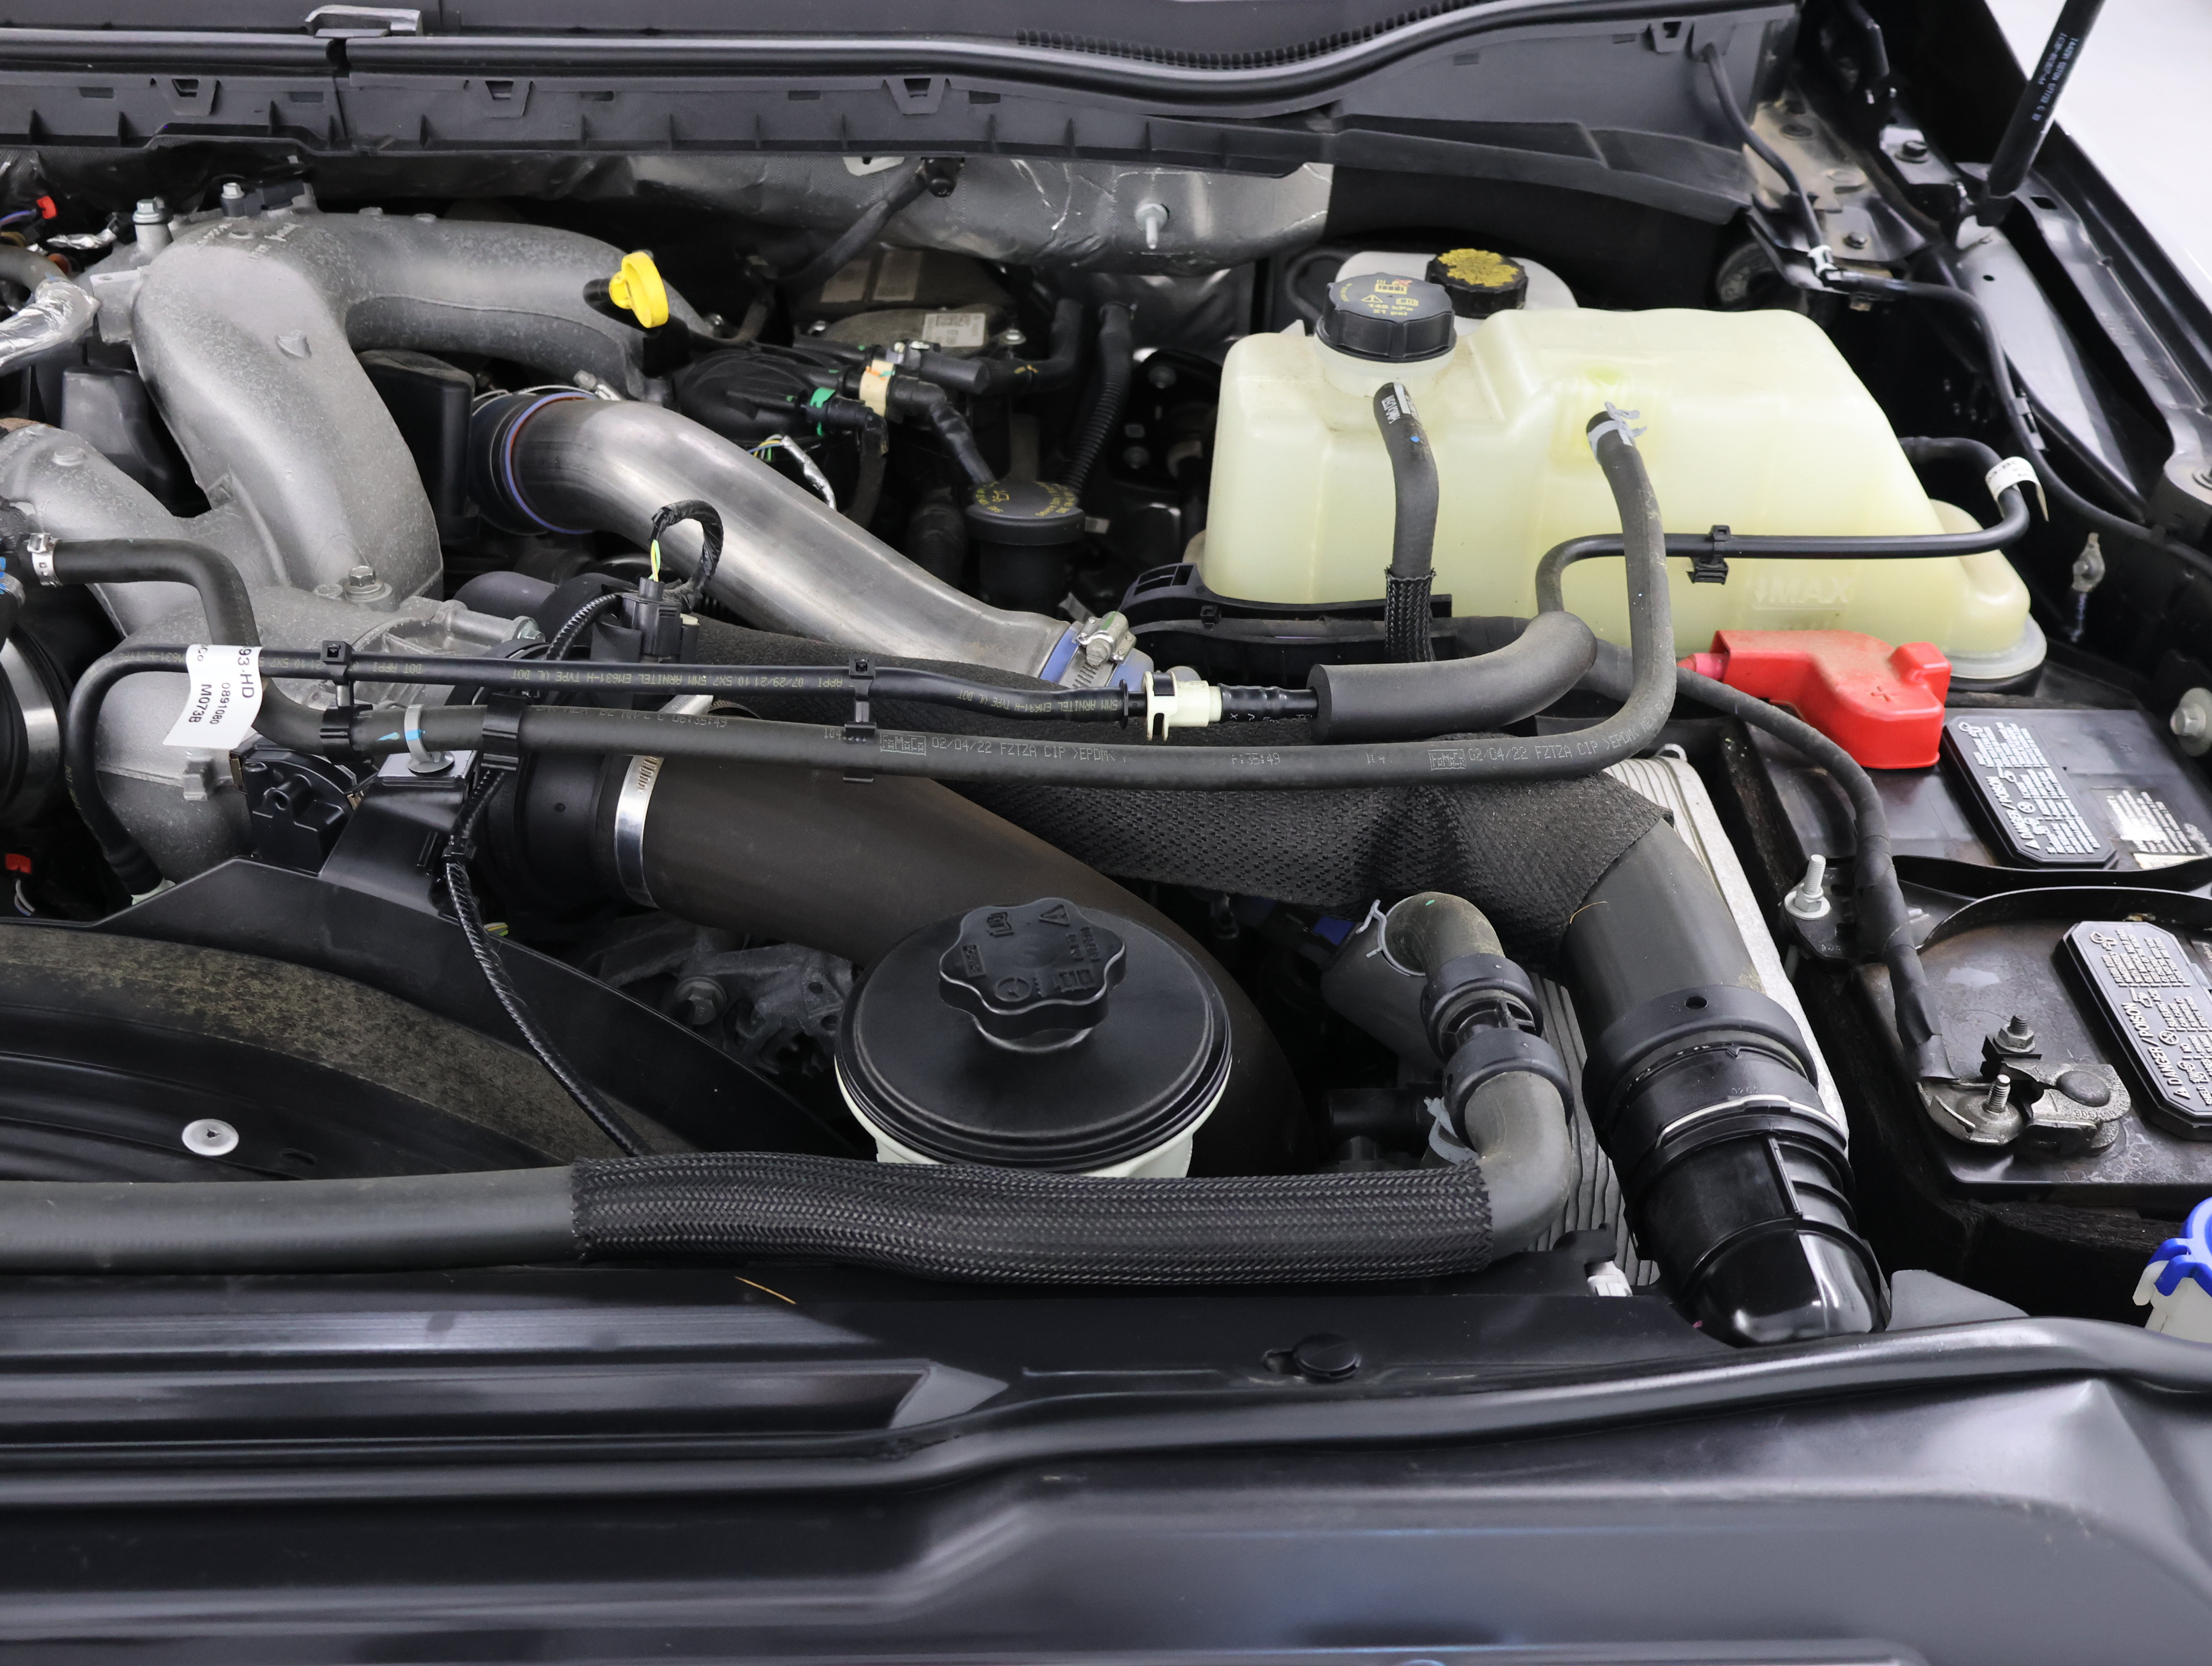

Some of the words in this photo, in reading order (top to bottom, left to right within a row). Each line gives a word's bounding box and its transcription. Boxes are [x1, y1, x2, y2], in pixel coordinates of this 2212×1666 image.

[1770, 577, 1853, 604] MAX
[403, 663, 422, 674] DOT
[511, 669, 530, 680] DOT
[555, 671, 580, 682] TYPE
[587, 672, 631, 684] EM631-H
[638, 674, 682, 685] ARNITEL
[755, 677, 803, 687] 07/29/21
[818, 677, 842, 687] APPI
[957, 689, 974, 701] DOT
[189, 684, 212, 723] M073B
[209, 682, 231, 724] 0891080
[1058, 700, 1095, 711] ARNITEL
[881, 734, 925, 752] FoMoCo
[931, 737, 992, 753] 02/04/22
[1044, 745, 1065, 759] CIP
[2148, 988, 2163, 1000] ACID
[2155, 1002, 2179, 1027] SULFURIC
[2179, 1043, 2193, 1052] NO
